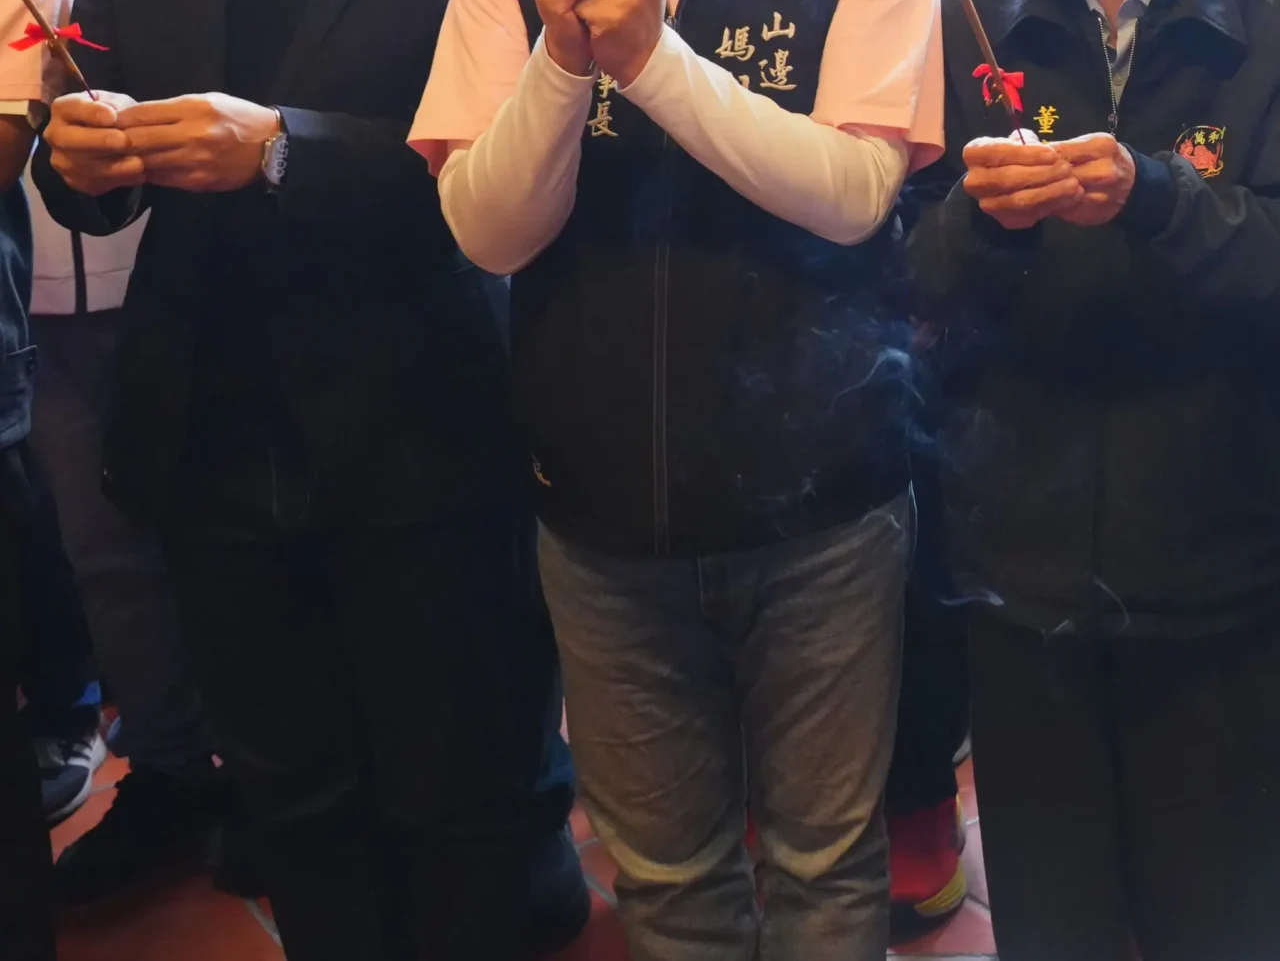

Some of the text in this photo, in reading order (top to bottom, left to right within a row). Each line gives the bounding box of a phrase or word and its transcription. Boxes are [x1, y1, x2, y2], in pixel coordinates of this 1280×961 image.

[715, 25, 756, 90] 媽
[759, 11, 797, 91] 山邊
[1032, 105, 1060, 144] 董
